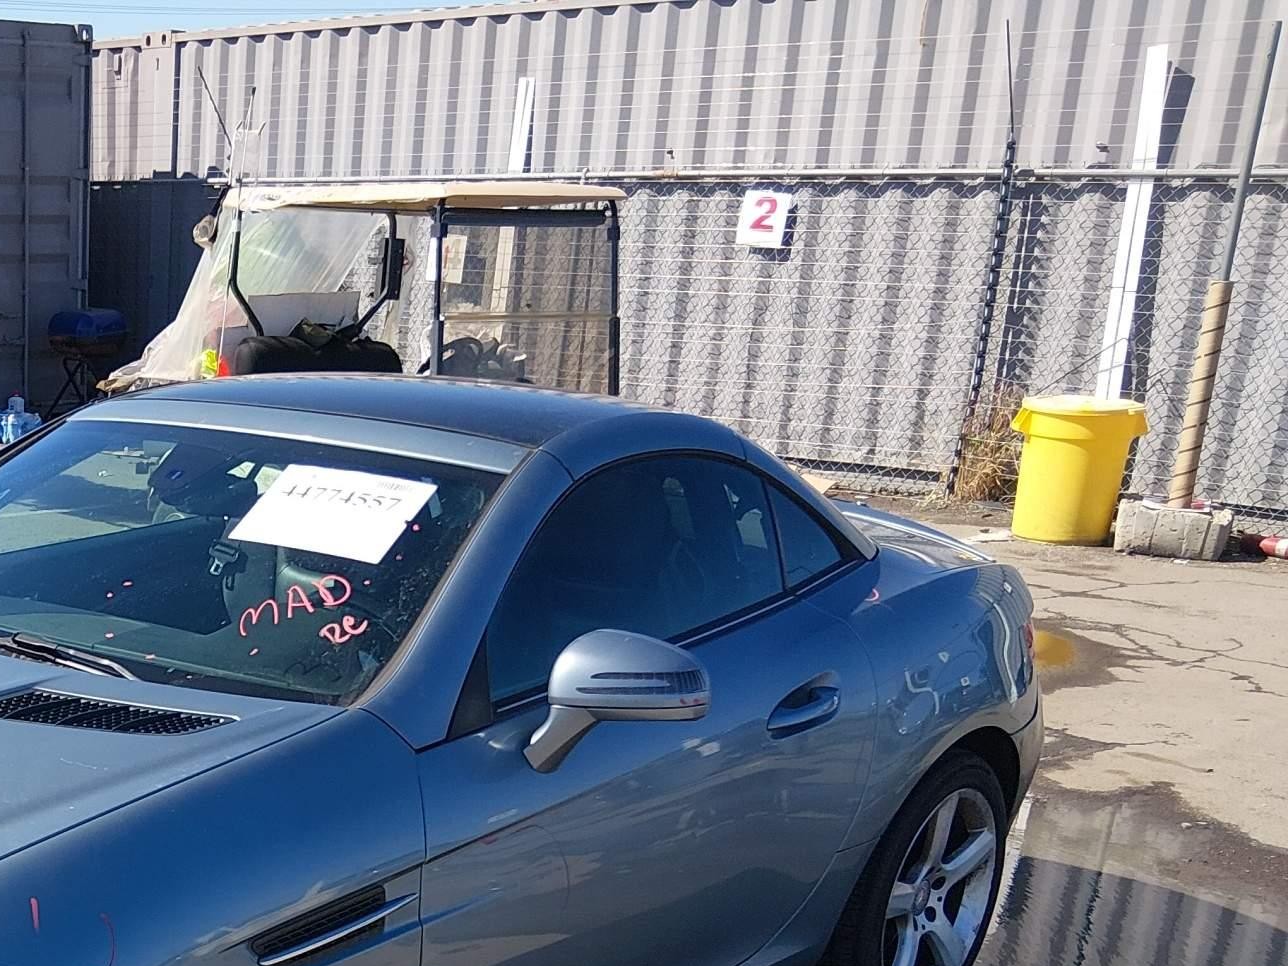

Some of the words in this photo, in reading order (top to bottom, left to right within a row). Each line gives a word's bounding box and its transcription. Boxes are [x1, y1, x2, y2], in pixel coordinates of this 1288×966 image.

[750, 196, 778, 232] 2
[282, 484, 402, 511] 44774557
[239, 574, 353, 637] MAD
